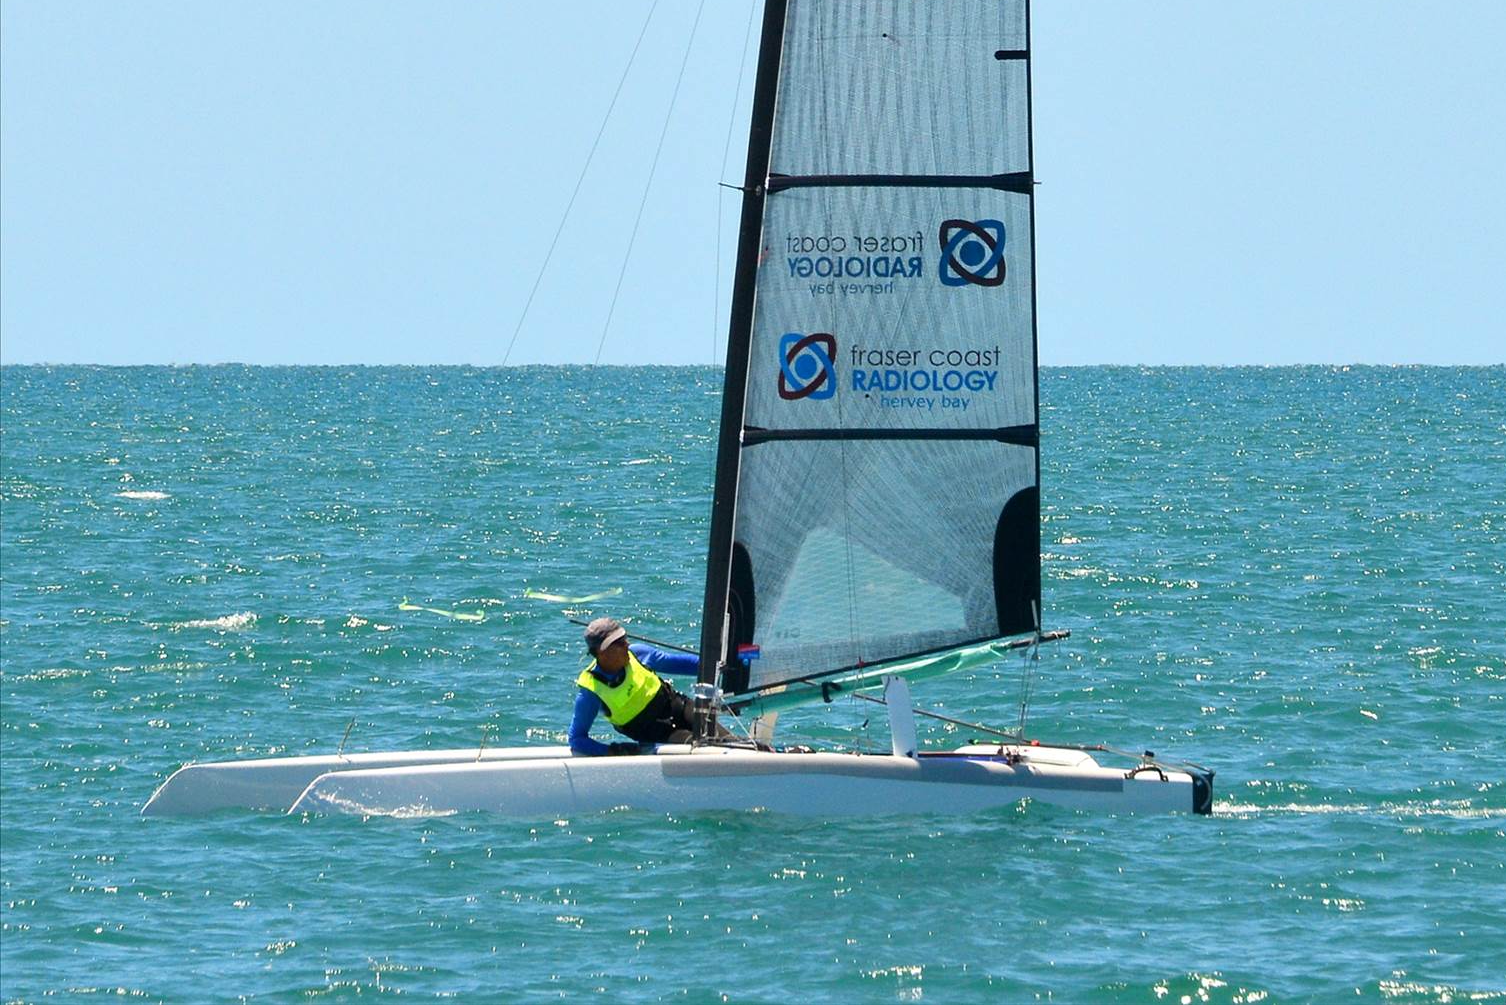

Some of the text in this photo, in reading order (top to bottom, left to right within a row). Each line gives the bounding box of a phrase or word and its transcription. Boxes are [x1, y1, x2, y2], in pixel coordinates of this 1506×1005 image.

[850, 344, 1001, 367] fraser coast
[851, 369, 999, 392] RADIOLOGY
[880, 395, 970, 412] hervey bay
